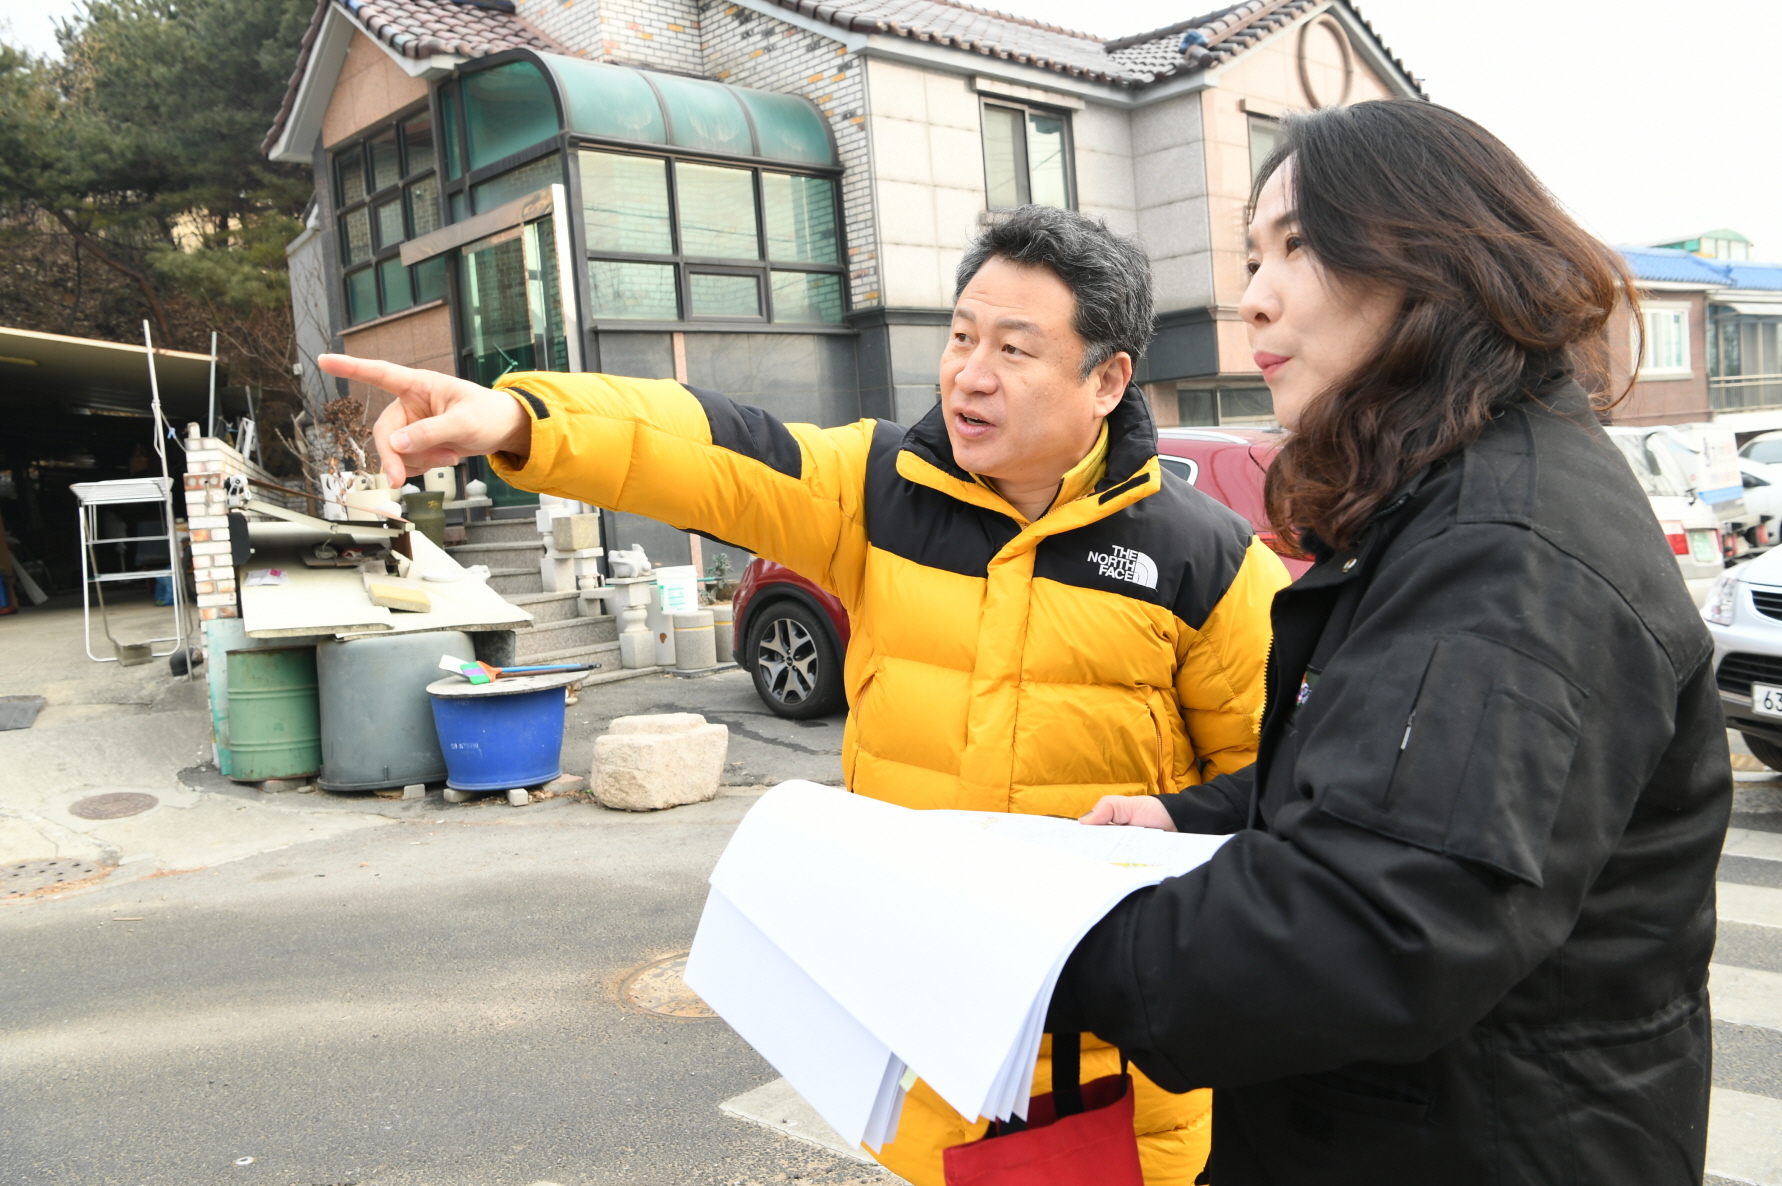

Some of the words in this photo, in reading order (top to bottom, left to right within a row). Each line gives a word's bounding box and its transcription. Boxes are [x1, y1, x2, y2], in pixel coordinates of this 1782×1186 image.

[1087, 551, 1136, 572] NORTH
[1112, 545, 1138, 561] THE
[1098, 564, 1134, 582] FACE
